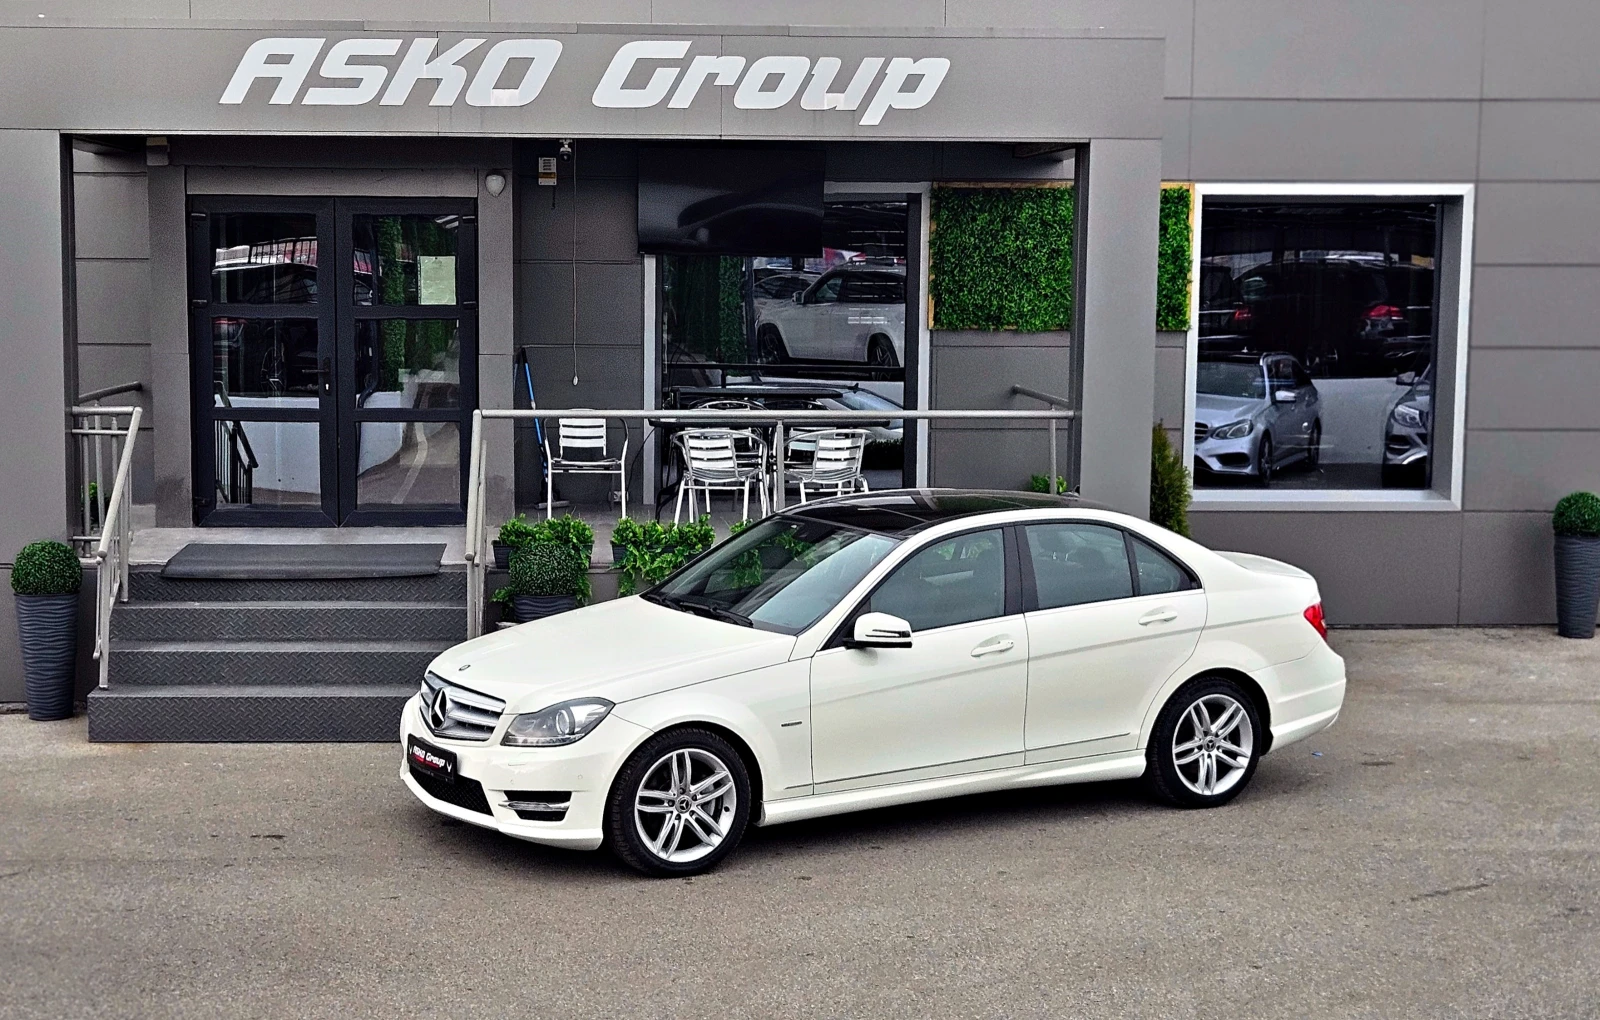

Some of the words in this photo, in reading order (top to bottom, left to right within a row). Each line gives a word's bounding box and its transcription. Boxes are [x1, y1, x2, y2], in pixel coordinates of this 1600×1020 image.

[219, 38, 563, 106] ASKO
[592, 41, 951, 126] Group
[425, 752, 446, 768] Group
